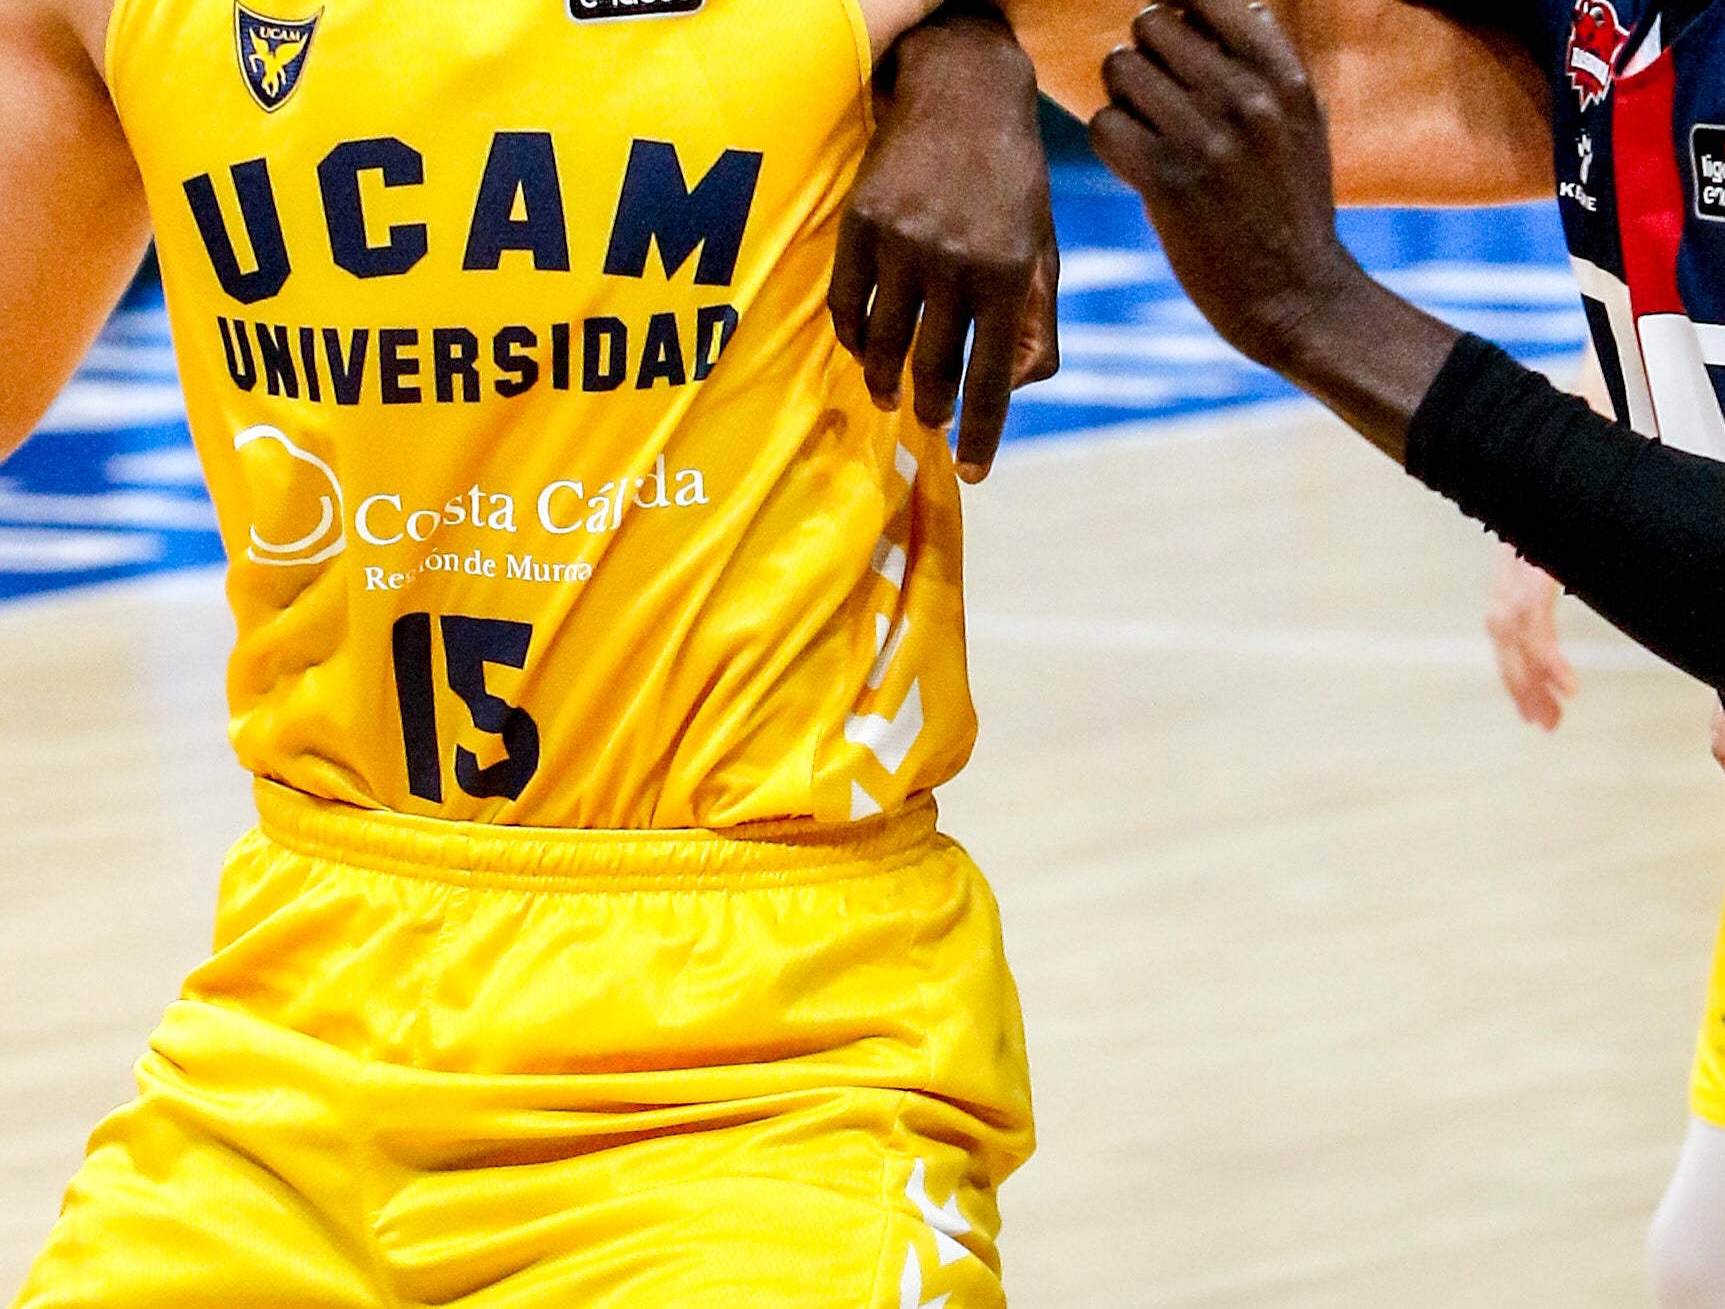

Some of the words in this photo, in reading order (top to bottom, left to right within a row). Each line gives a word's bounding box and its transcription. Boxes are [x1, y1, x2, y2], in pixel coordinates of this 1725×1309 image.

[259, 26, 300, 42] UCAM
[182, 131, 764, 305] UCAM
[217, 304, 740, 406] UNIVERSIDAD
[355, 483, 517, 546] Costa
[537, 453, 710, 535] Cálda
[464, 550, 497, 578] de
[391, 611, 541, 804] 15
